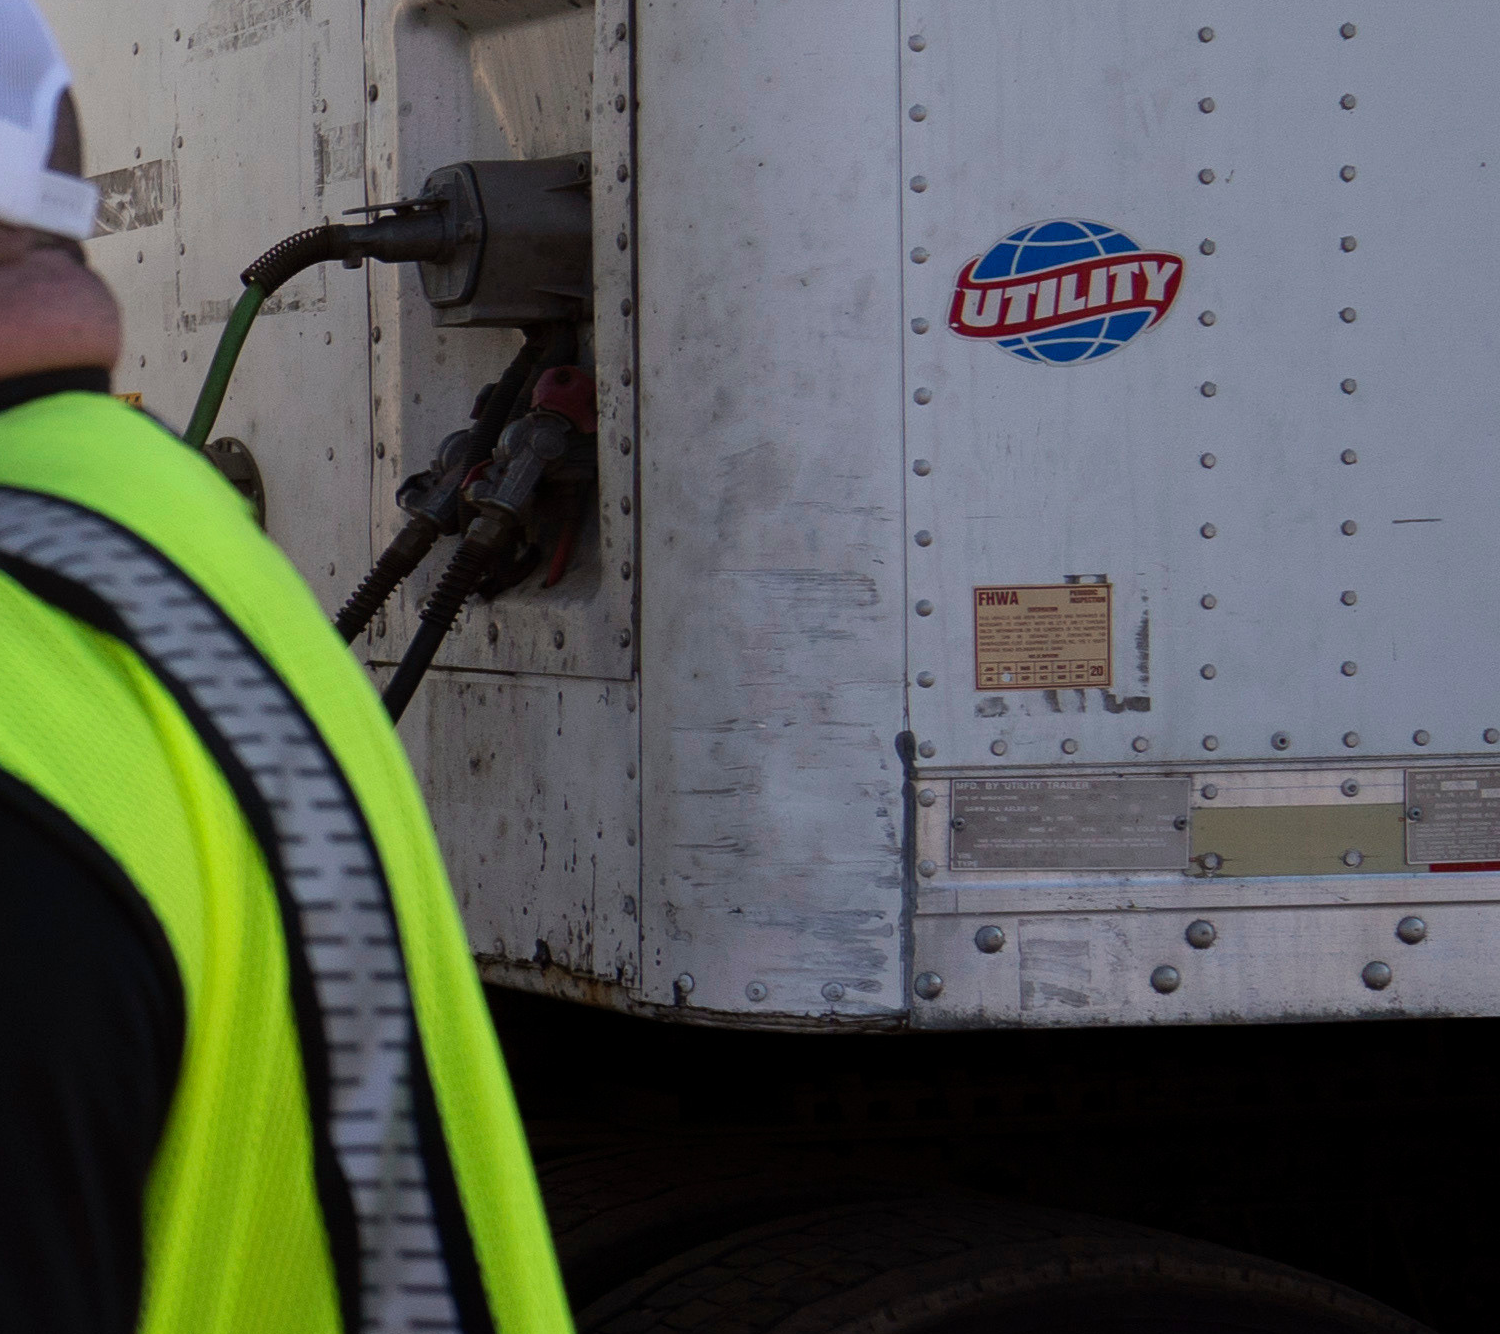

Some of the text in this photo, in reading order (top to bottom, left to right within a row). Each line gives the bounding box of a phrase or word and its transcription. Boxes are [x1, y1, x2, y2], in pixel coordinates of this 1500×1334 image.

[962, 260, 1179, 328] UTILITY
[978, 590, 1019, 606] FHWA
[1090, 665, 1103, 676] 20
[985, 782, 998, 790] BY
[1046, 781, 1089, 789] TRAILER
